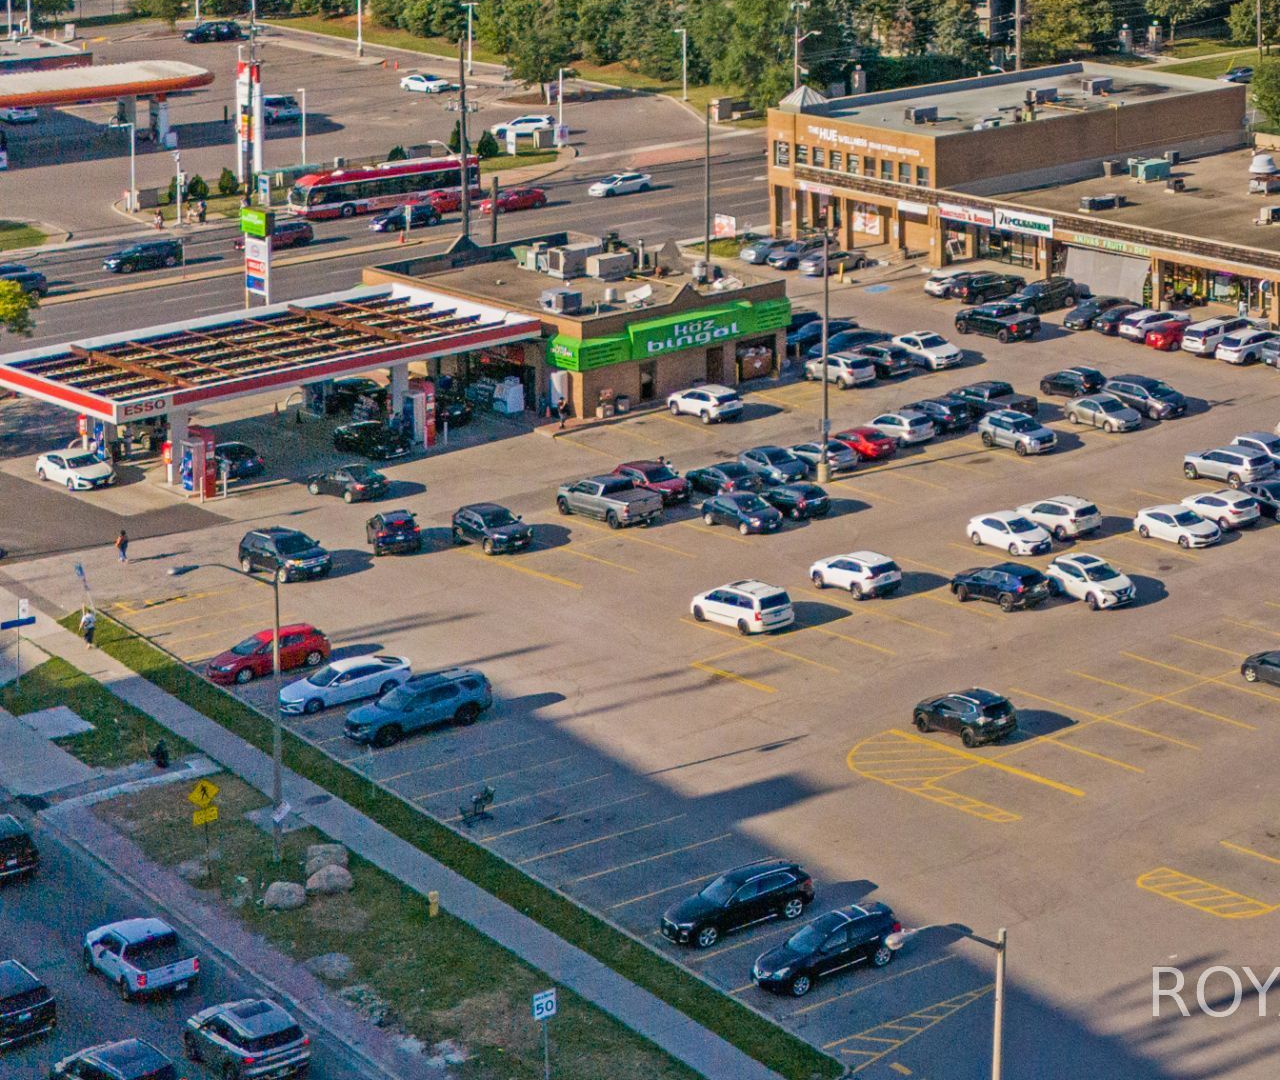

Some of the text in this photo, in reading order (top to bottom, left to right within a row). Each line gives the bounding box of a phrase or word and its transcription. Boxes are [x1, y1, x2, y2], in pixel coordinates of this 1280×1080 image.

[819, 128, 838, 142] HUE
[124, 399, 166, 416] ESSO
[536, 999, 554, 1016] 50
